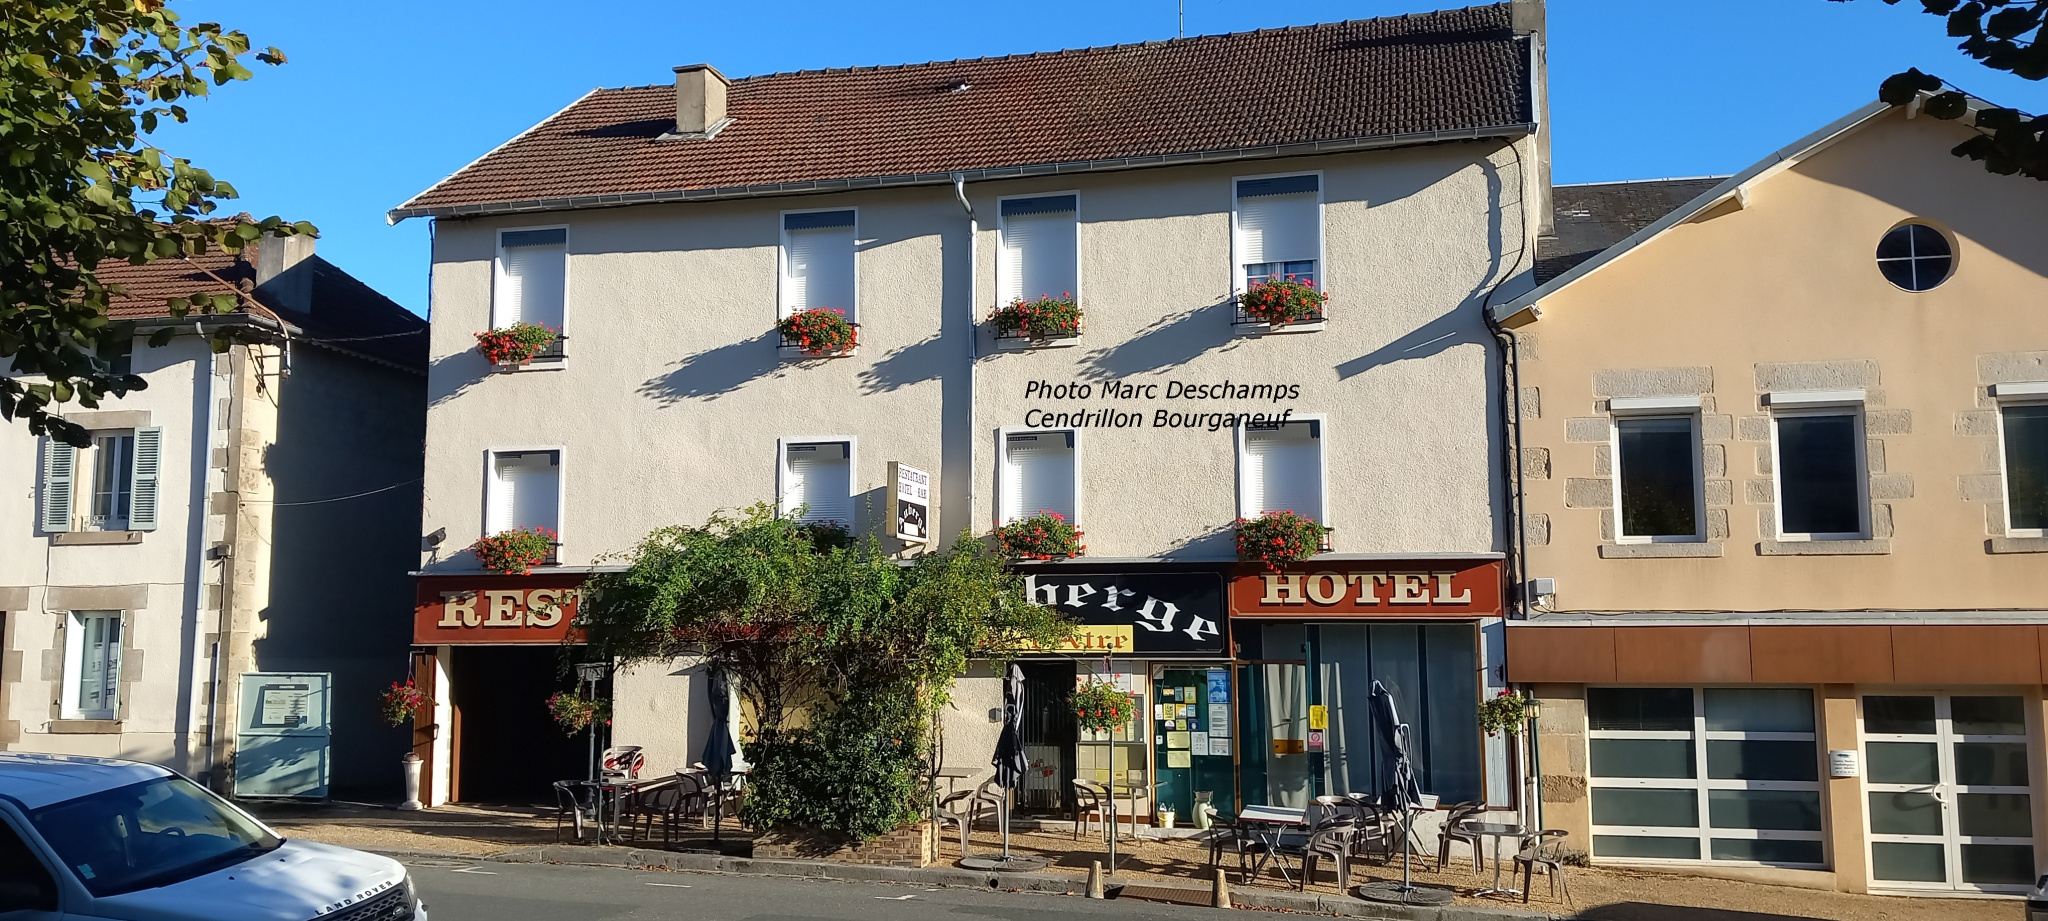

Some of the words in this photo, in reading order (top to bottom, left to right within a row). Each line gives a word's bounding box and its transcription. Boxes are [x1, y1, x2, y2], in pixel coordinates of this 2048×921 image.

[898, 467, 927, 486] RESTAURANT
[899, 482, 912, 495] HOTEL
[917, 487, 927, 499] BAR
[1260, 571, 1472, 606] HOTEL
[437, 588, 602, 628] REST
[1023, 574, 1220, 641] berge
[314, 898, 352, 916] LAND
[356, 880, 393, 901] ROVER
